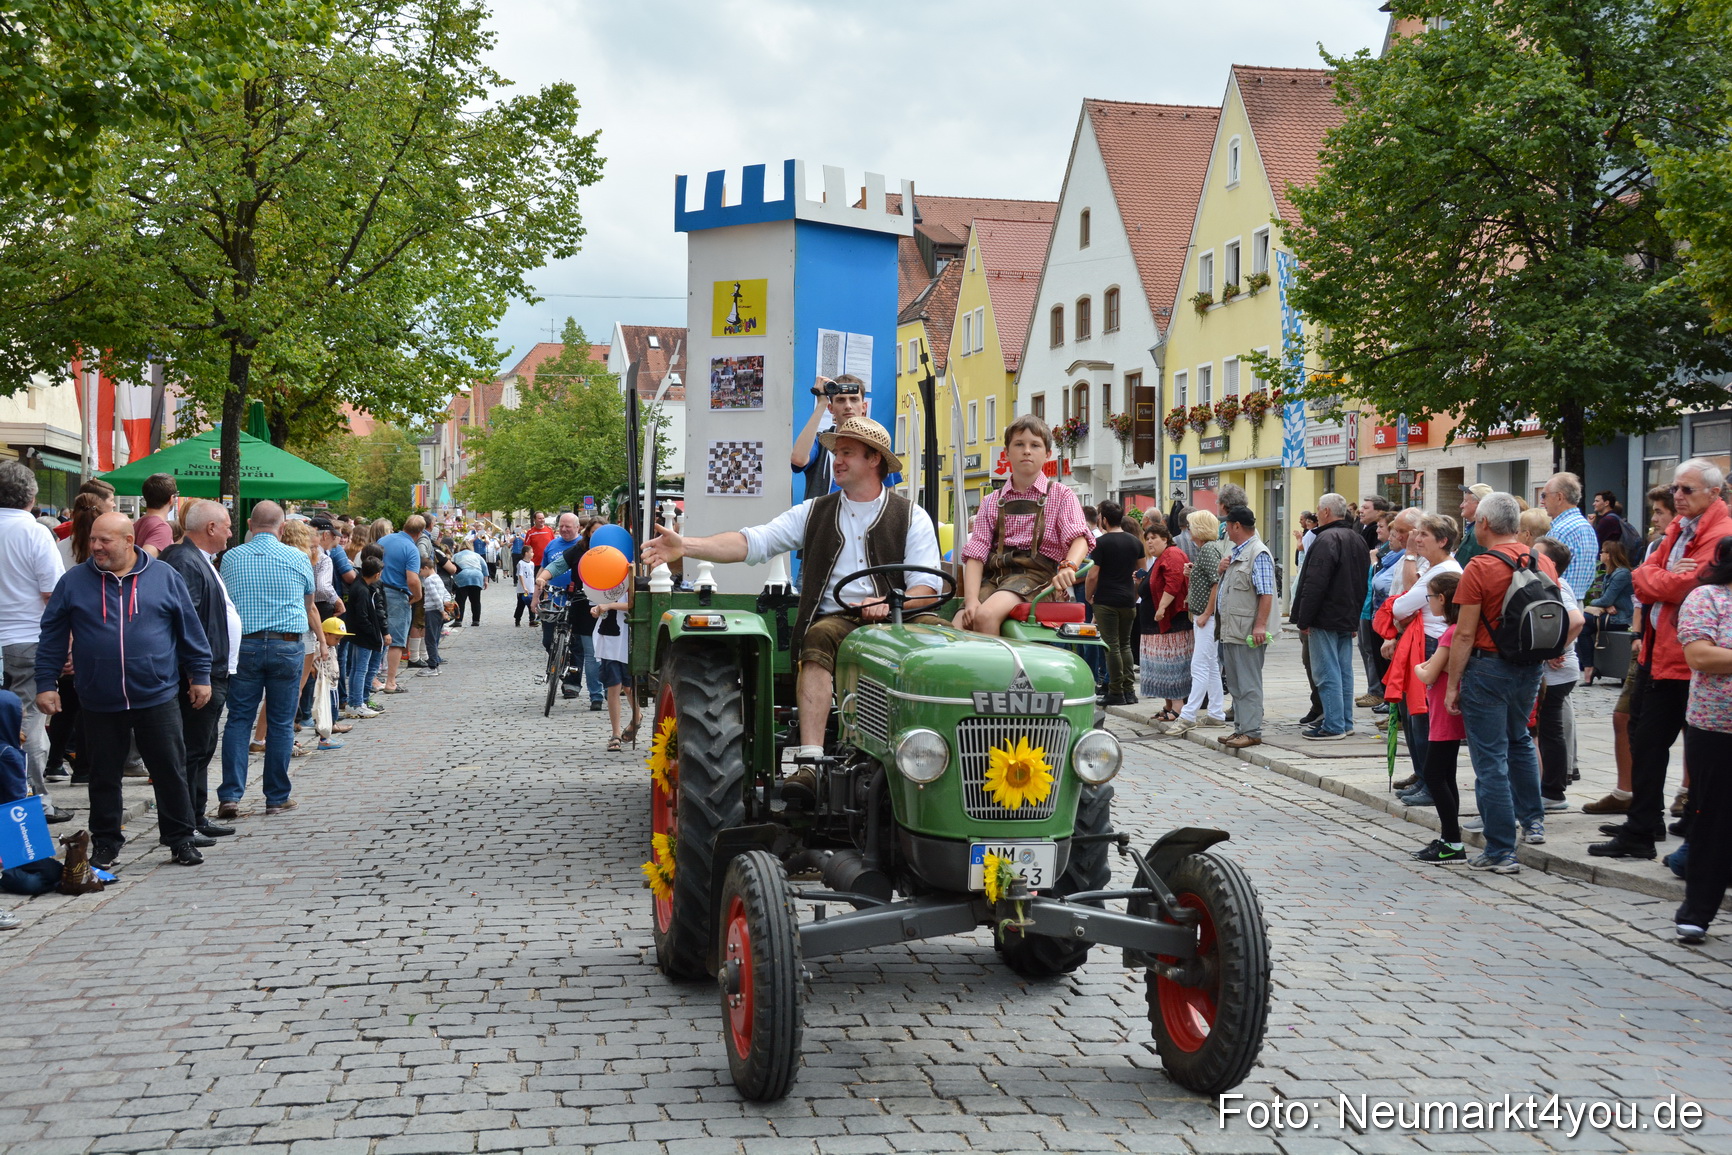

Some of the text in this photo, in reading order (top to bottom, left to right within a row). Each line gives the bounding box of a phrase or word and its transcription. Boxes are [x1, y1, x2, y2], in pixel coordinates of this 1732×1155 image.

[1201, 441, 1212, 450] WOLLE
[1312, 434, 1340, 447] RIALTO KINO
[174, 468, 274, 478] Lammbräu
[1173, 457, 1184, 478] P
[1192, 478, 1205, 488] WOLLE
[972, 691, 1065, 714] FENDT
[19, 822, 36, 860] Lebenshilfe
[988, 847, 1015, 865] NM
